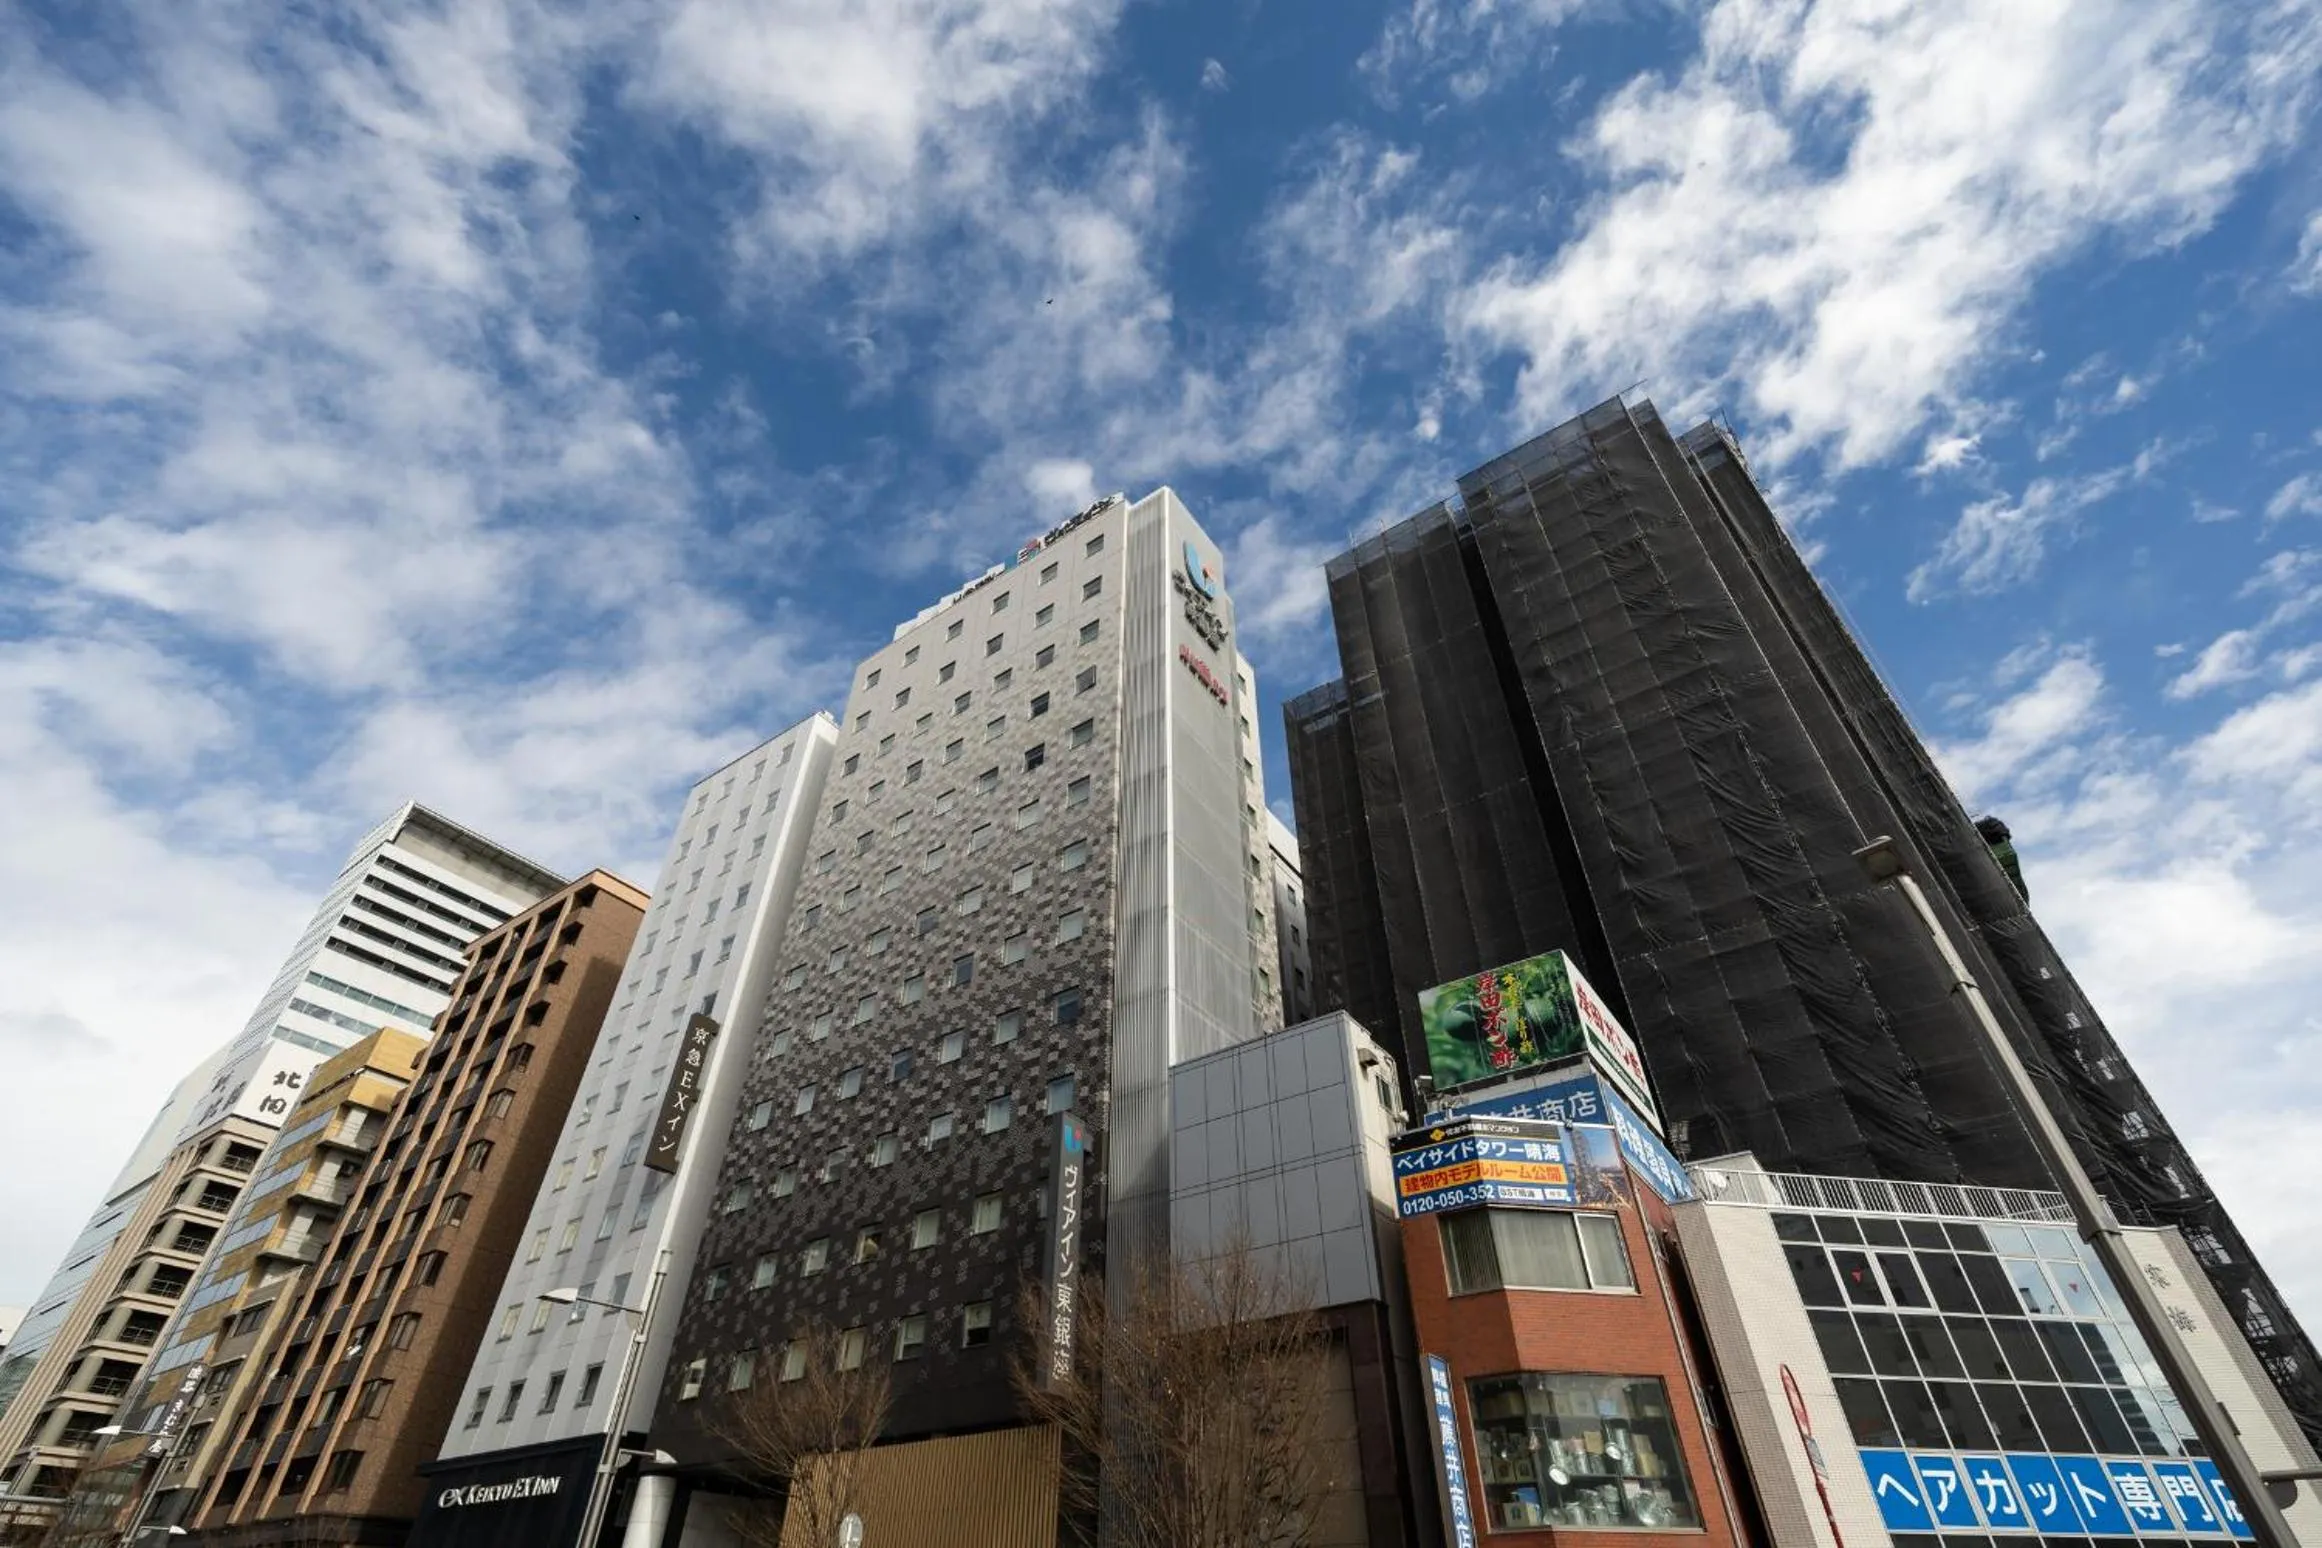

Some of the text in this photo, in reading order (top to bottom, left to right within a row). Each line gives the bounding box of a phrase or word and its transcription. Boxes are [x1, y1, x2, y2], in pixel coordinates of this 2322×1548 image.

[658, 1026, 710, 1153] 京急EXイン
[1397, 1138, 1562, 1170] ベイサイドタワー晴海
[1404, 1161, 1563, 1194] 建物内モデルルーム公開
[1403, 1184, 1495, 1215] 0120-050-352
[465, 1483, 512, 1505] KEIKYU
[511, 1476, 534, 1499] EX
[530, 1475, 562, 1497] INN
